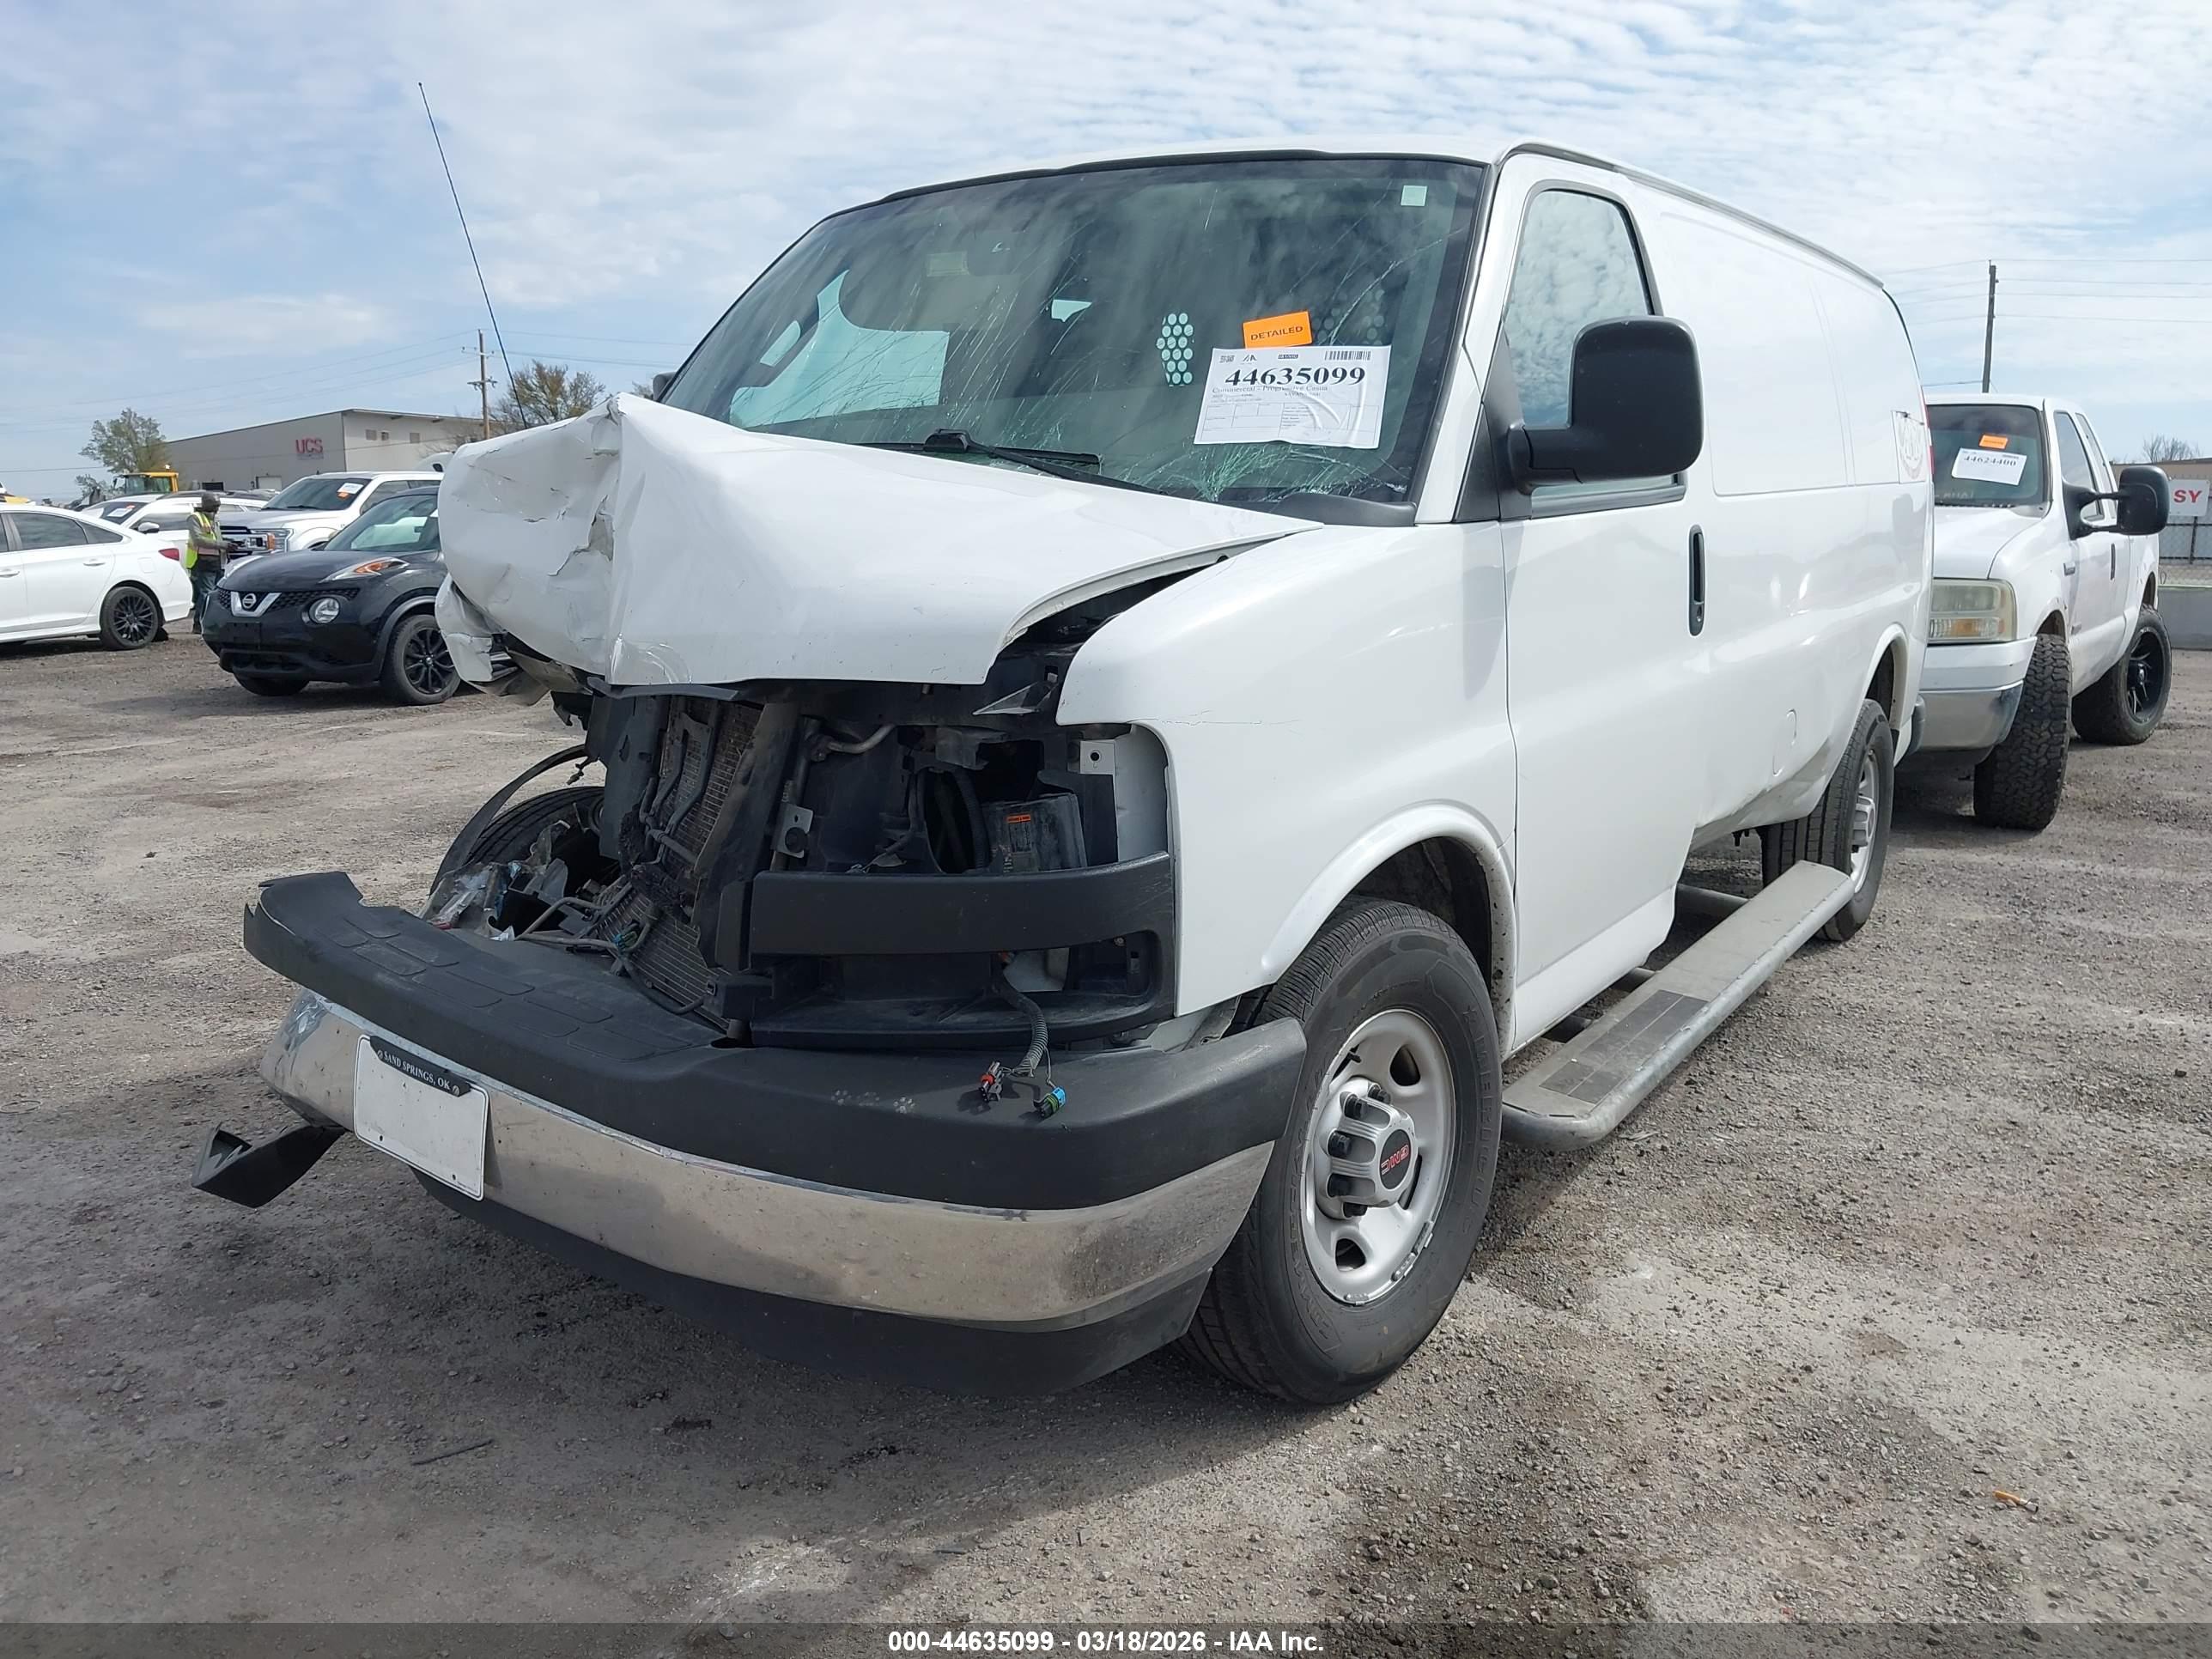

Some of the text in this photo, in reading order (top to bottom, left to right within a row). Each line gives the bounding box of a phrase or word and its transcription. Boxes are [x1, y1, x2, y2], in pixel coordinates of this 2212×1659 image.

[1250, 325, 1304, 341] DETAILED
[1225, 368, 1365, 386] 44635099
[295, 438, 324, 453] UCS
[2173, 489, 2203, 503] SY
[384, 1050, 451, 1091] SAND SPRINGS, OK
[1380, 1144, 1409, 1176] GMC
